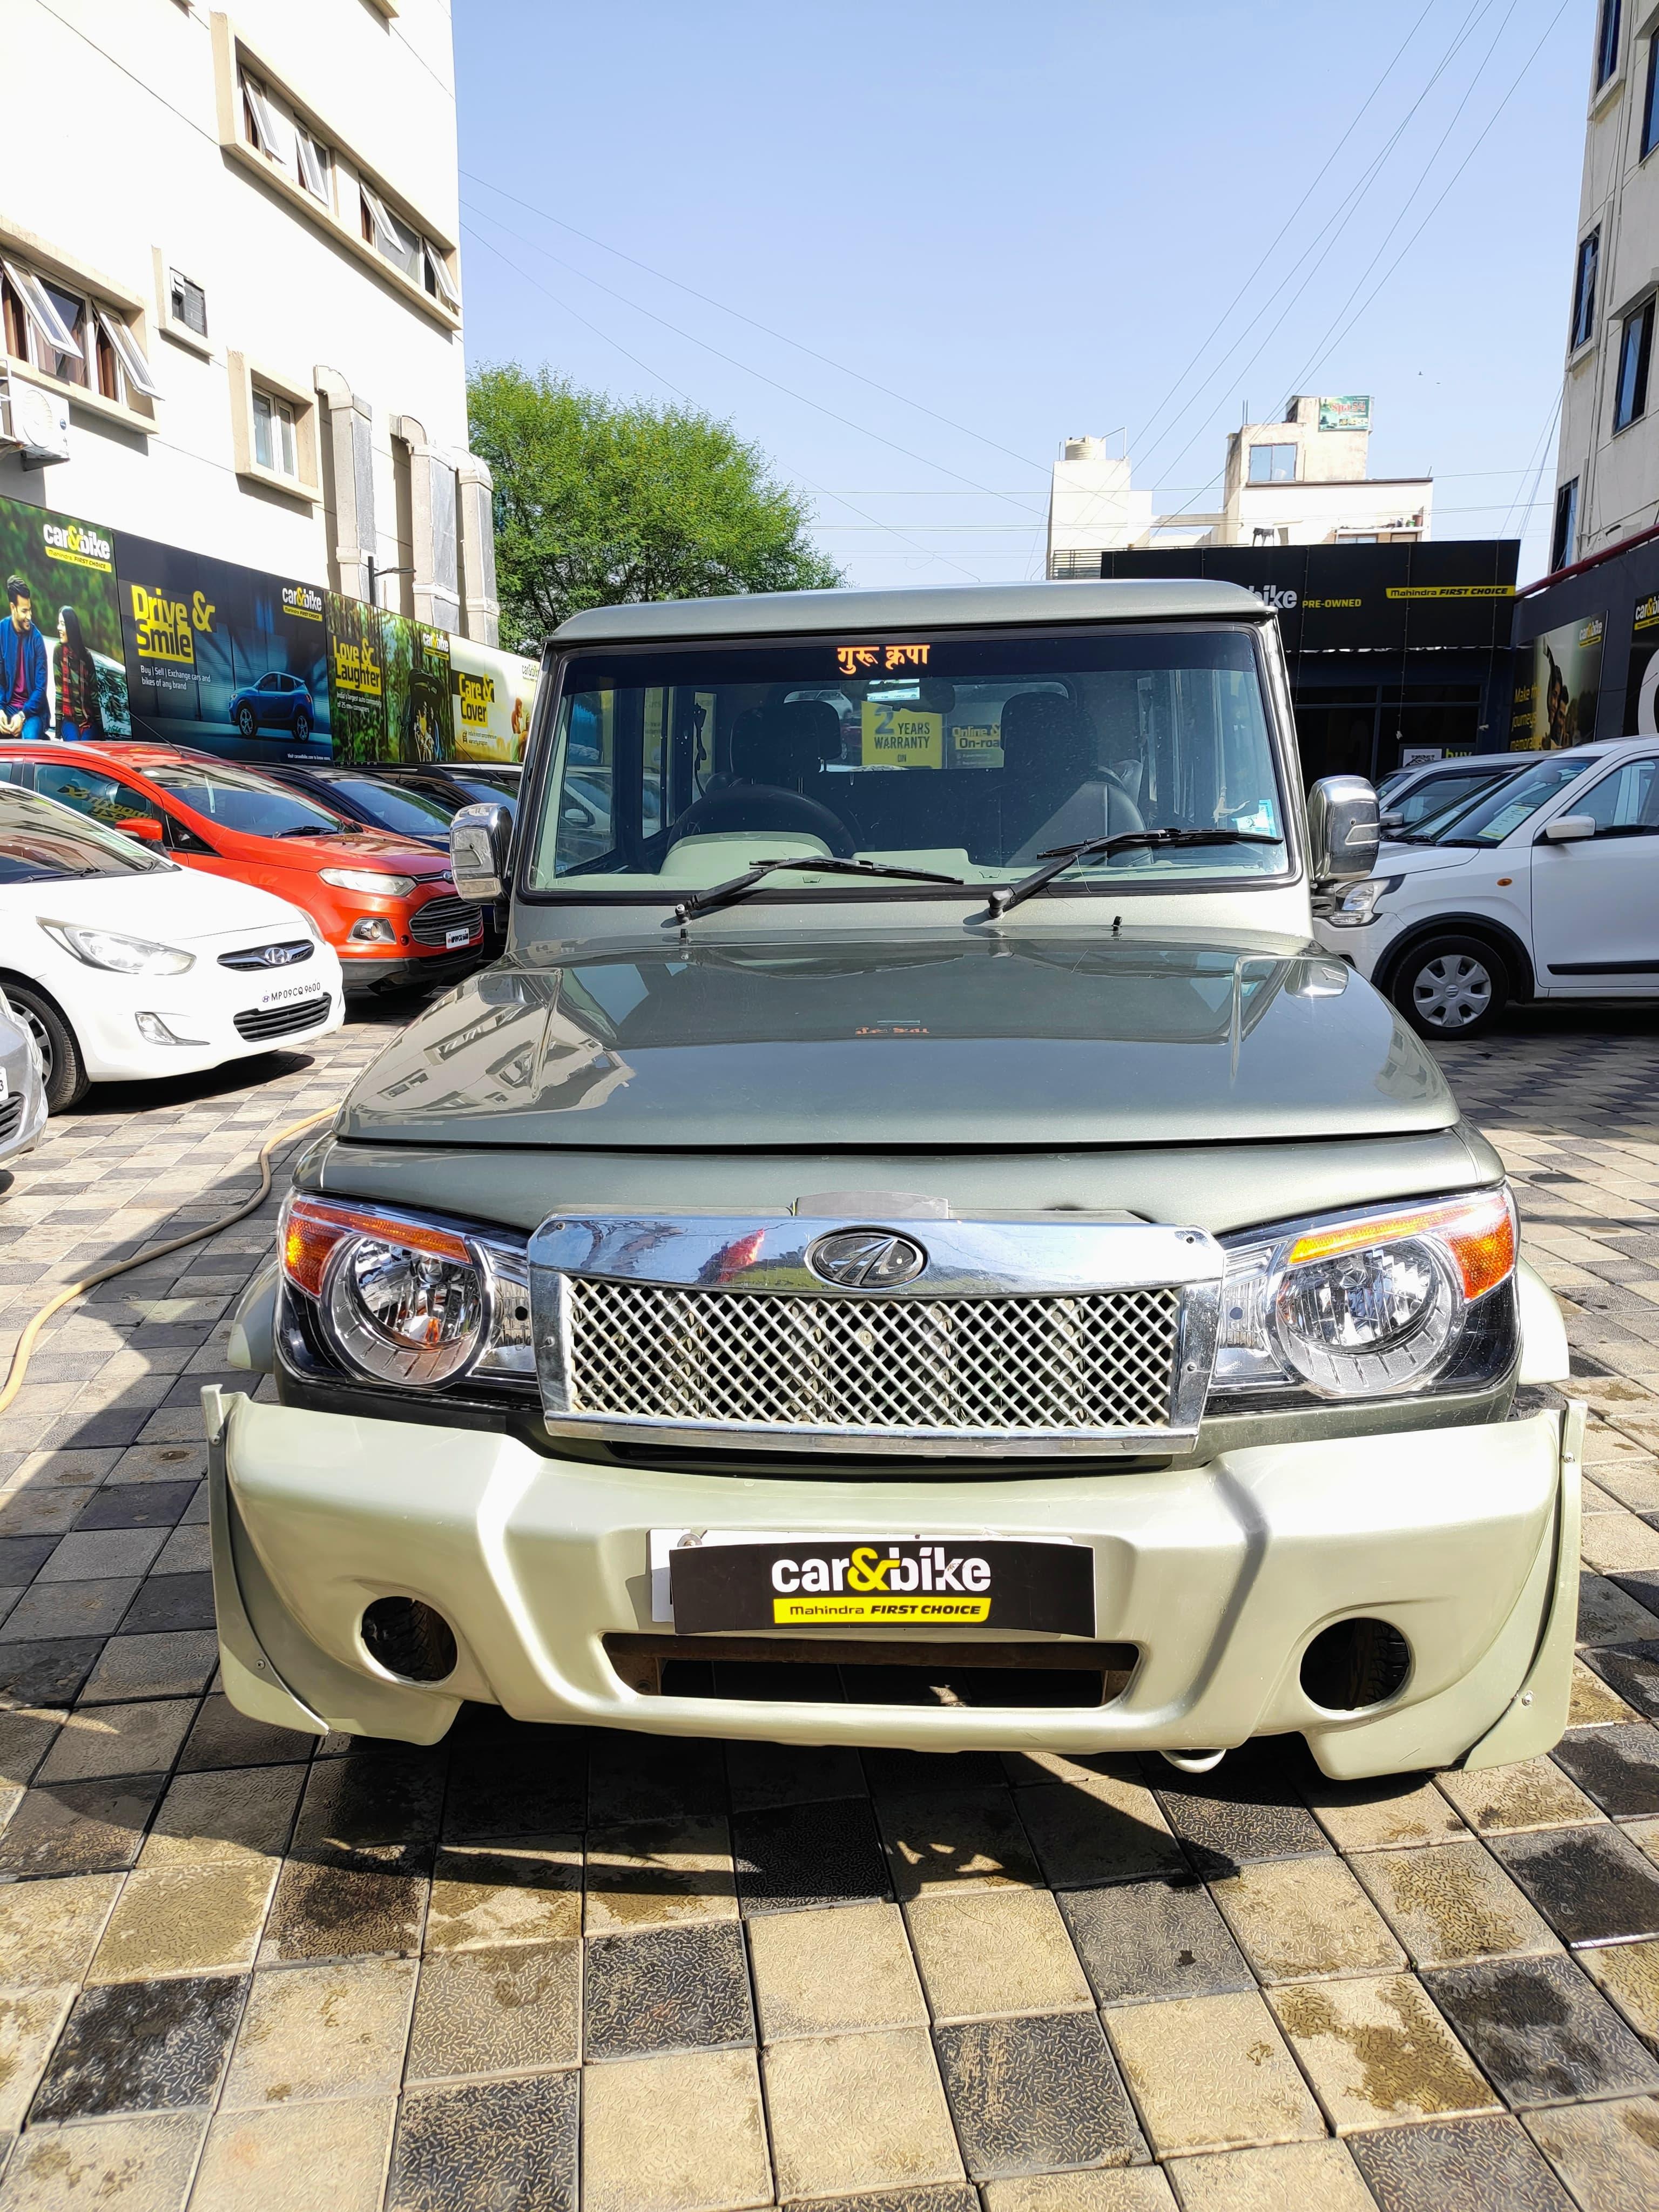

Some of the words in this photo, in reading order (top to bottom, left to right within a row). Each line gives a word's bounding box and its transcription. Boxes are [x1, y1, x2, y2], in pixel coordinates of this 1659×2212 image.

[43, 524, 110, 559] car&bike
[74, 557, 88, 565] FIRST
[89, 561, 106, 569] CHOICE
[131, 584, 188, 628] Drive
[192, 590, 215, 632] &
[282, 586, 322, 611] car&bike
[1302, 599, 1361, 609] PRE-OWNED
[135, 618, 192, 658] Smile
[333, 635, 359, 662] Love
[361, 638, 374, 666] &
[140, 665, 151, 676] Buy
[155, 667, 164, 676] Sell
[167, 669, 191, 680] Exchange
[141, 677, 156, 686] bikes
[162, 681, 172, 690] any
[172, 680, 187, 690] brand
[335, 657, 380, 689] Laughter
[458, 673, 482, 700] Care
[461, 697, 487, 722] Cover
[874, 706, 894, 735] 2
[898, 723, 930, 735] YEARS
[874, 736, 930, 750] WARRANTY
[952, 726, 988, 737] Online
[960, 738, 1000, 748] On-roa
[897, 754, 907, 763] ON
[772, 1547, 992, 1593] car&bike
[790, 1606, 865, 1615] Mahindra
[871, 1605, 919, 1615] FIRST
[921, 1605, 981, 1615] CHOICE
